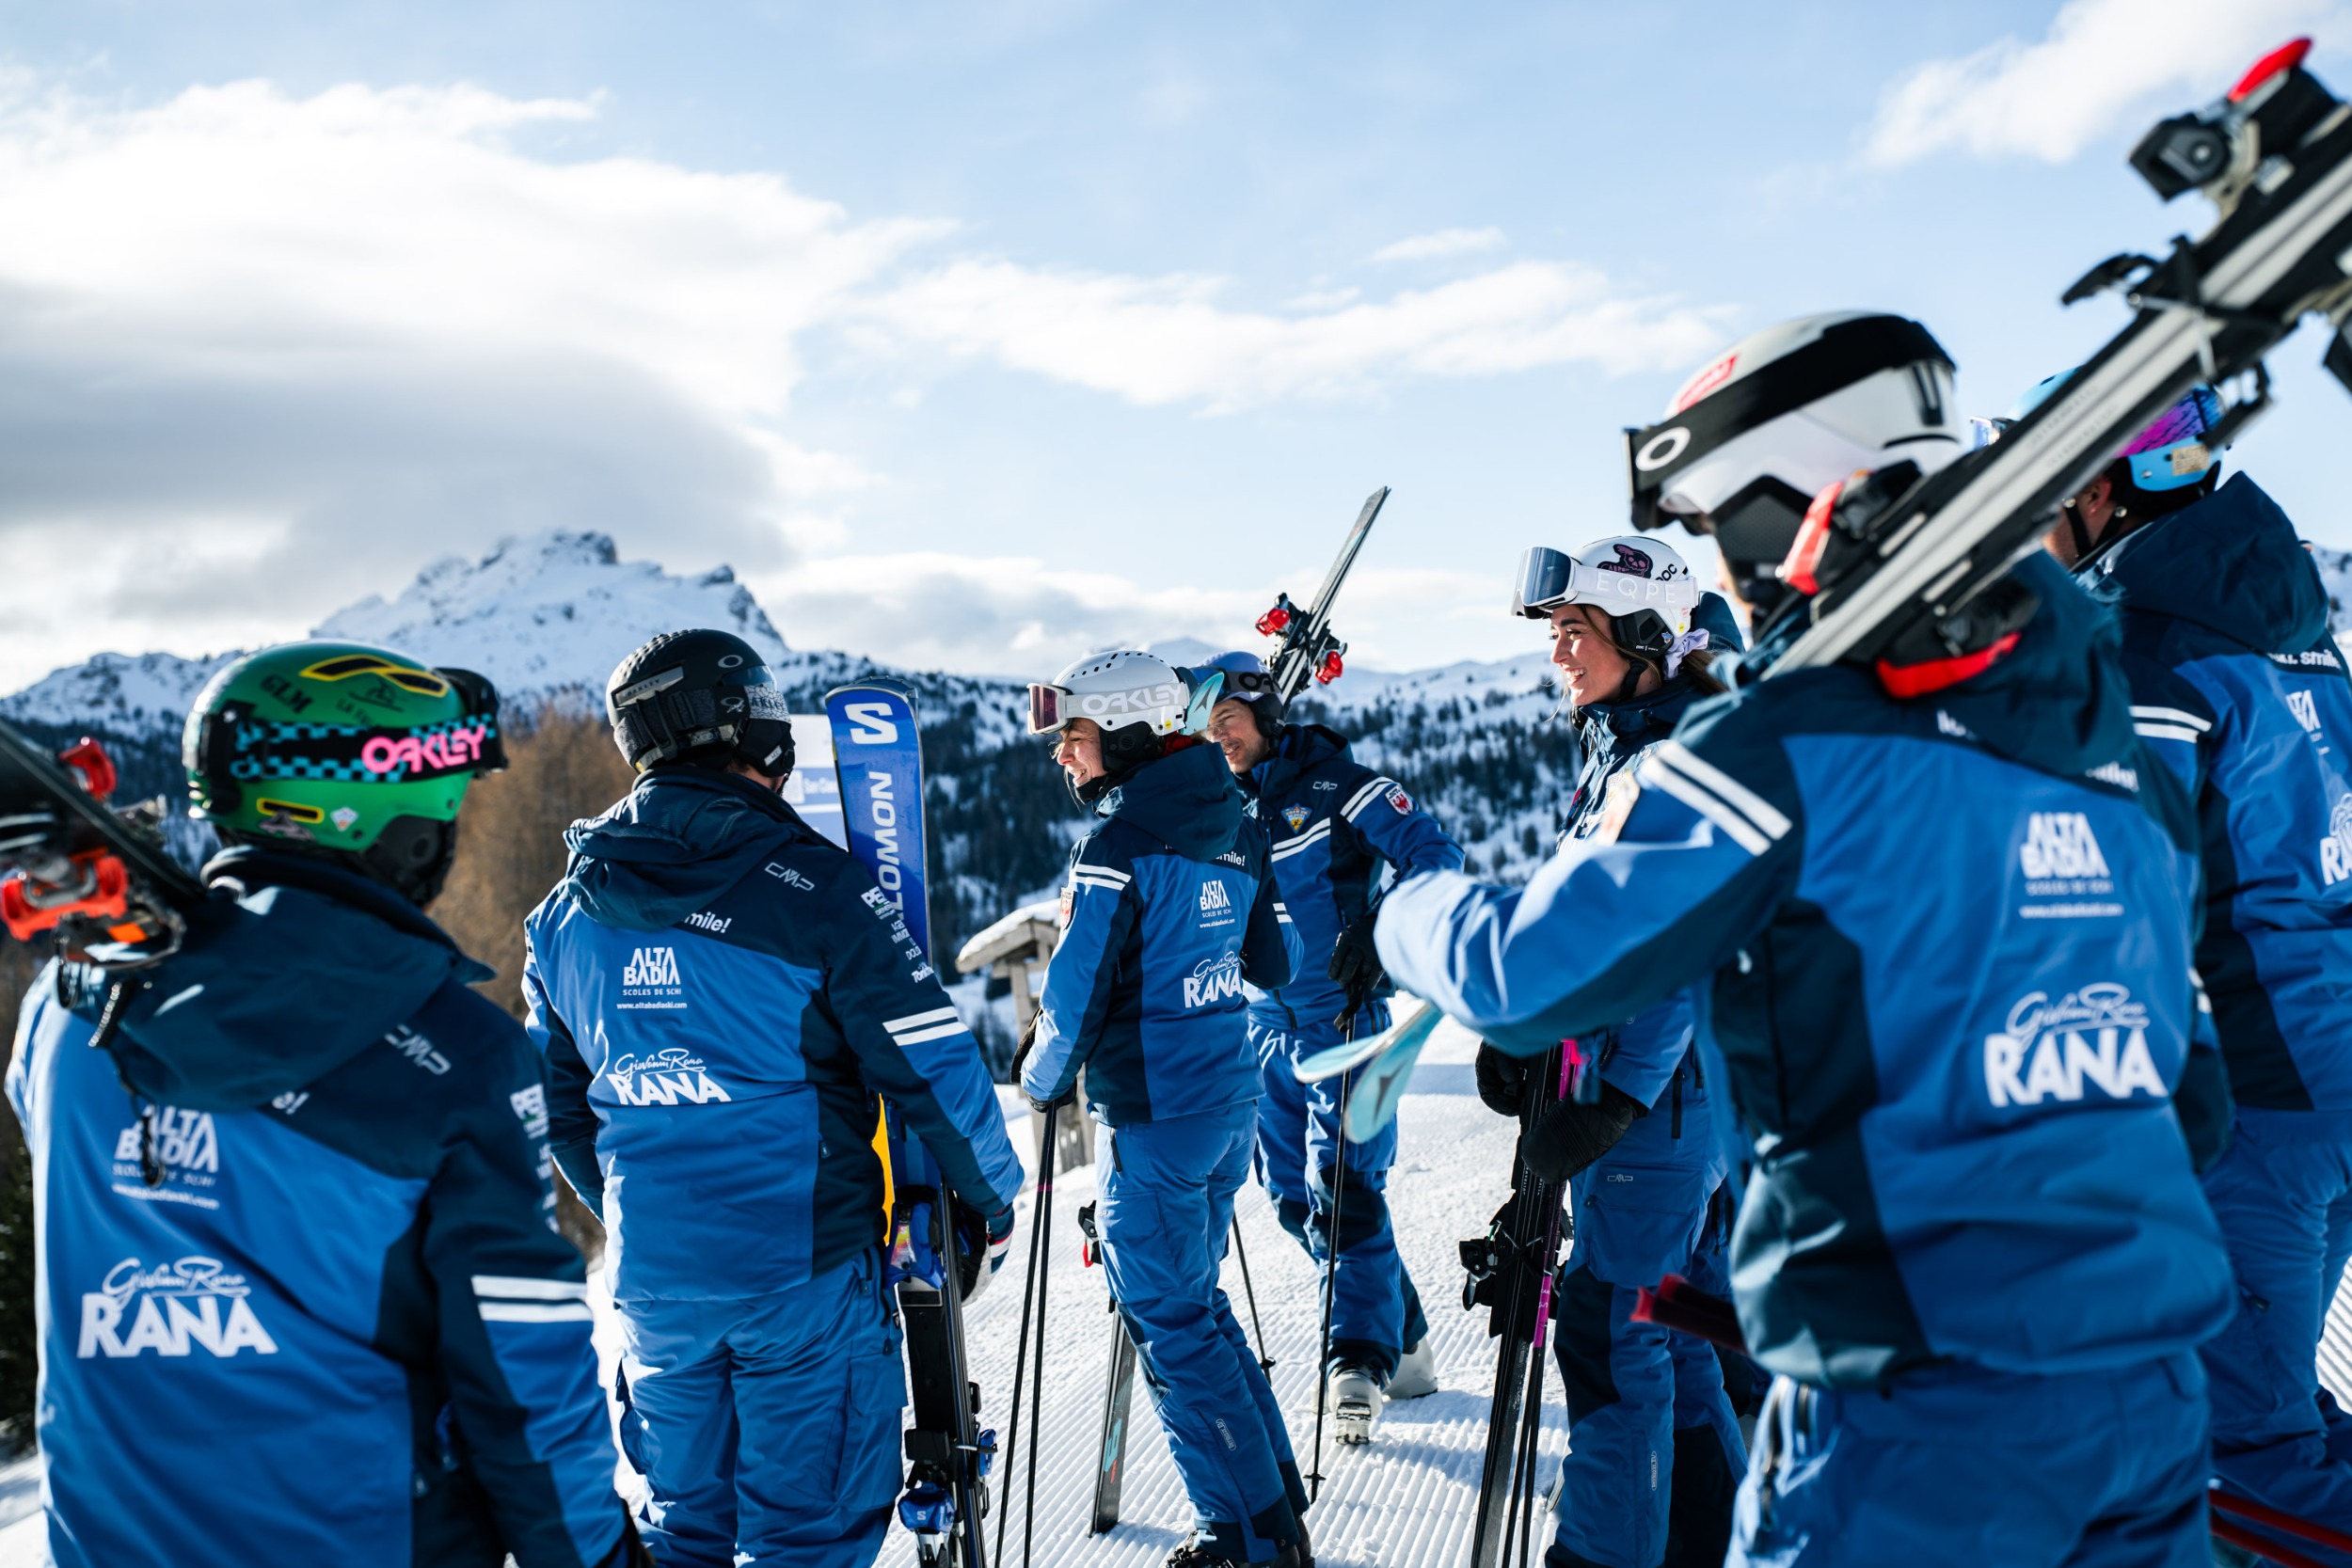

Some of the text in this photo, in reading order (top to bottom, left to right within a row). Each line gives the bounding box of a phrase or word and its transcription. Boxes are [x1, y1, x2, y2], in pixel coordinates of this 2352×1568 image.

[1597, 572, 1676, 603] EQPE
[1082, 683, 1182, 715] OAKLEY
[361, 724, 486, 774] OAKLEY
[1312, 781, 1338, 790] CMP
[868, 771, 904, 921] LOMON
[765, 862, 815, 892] CMP
[1202, 879, 1224, 895] ALTA
[1200, 895, 1231, 911] BADIA
[685, 911, 732, 933] mile!
[630, 947, 675, 968] ALTA
[623, 966, 681, 986] BADIA
[1184, 966, 1243, 1008] RANA
[1983, 1027, 2169, 1107] RANA
[606, 1071, 732, 1106] RANA
[1607, 1174, 1633, 1182] CMP
[76, 1292, 278, 1358] RANA
